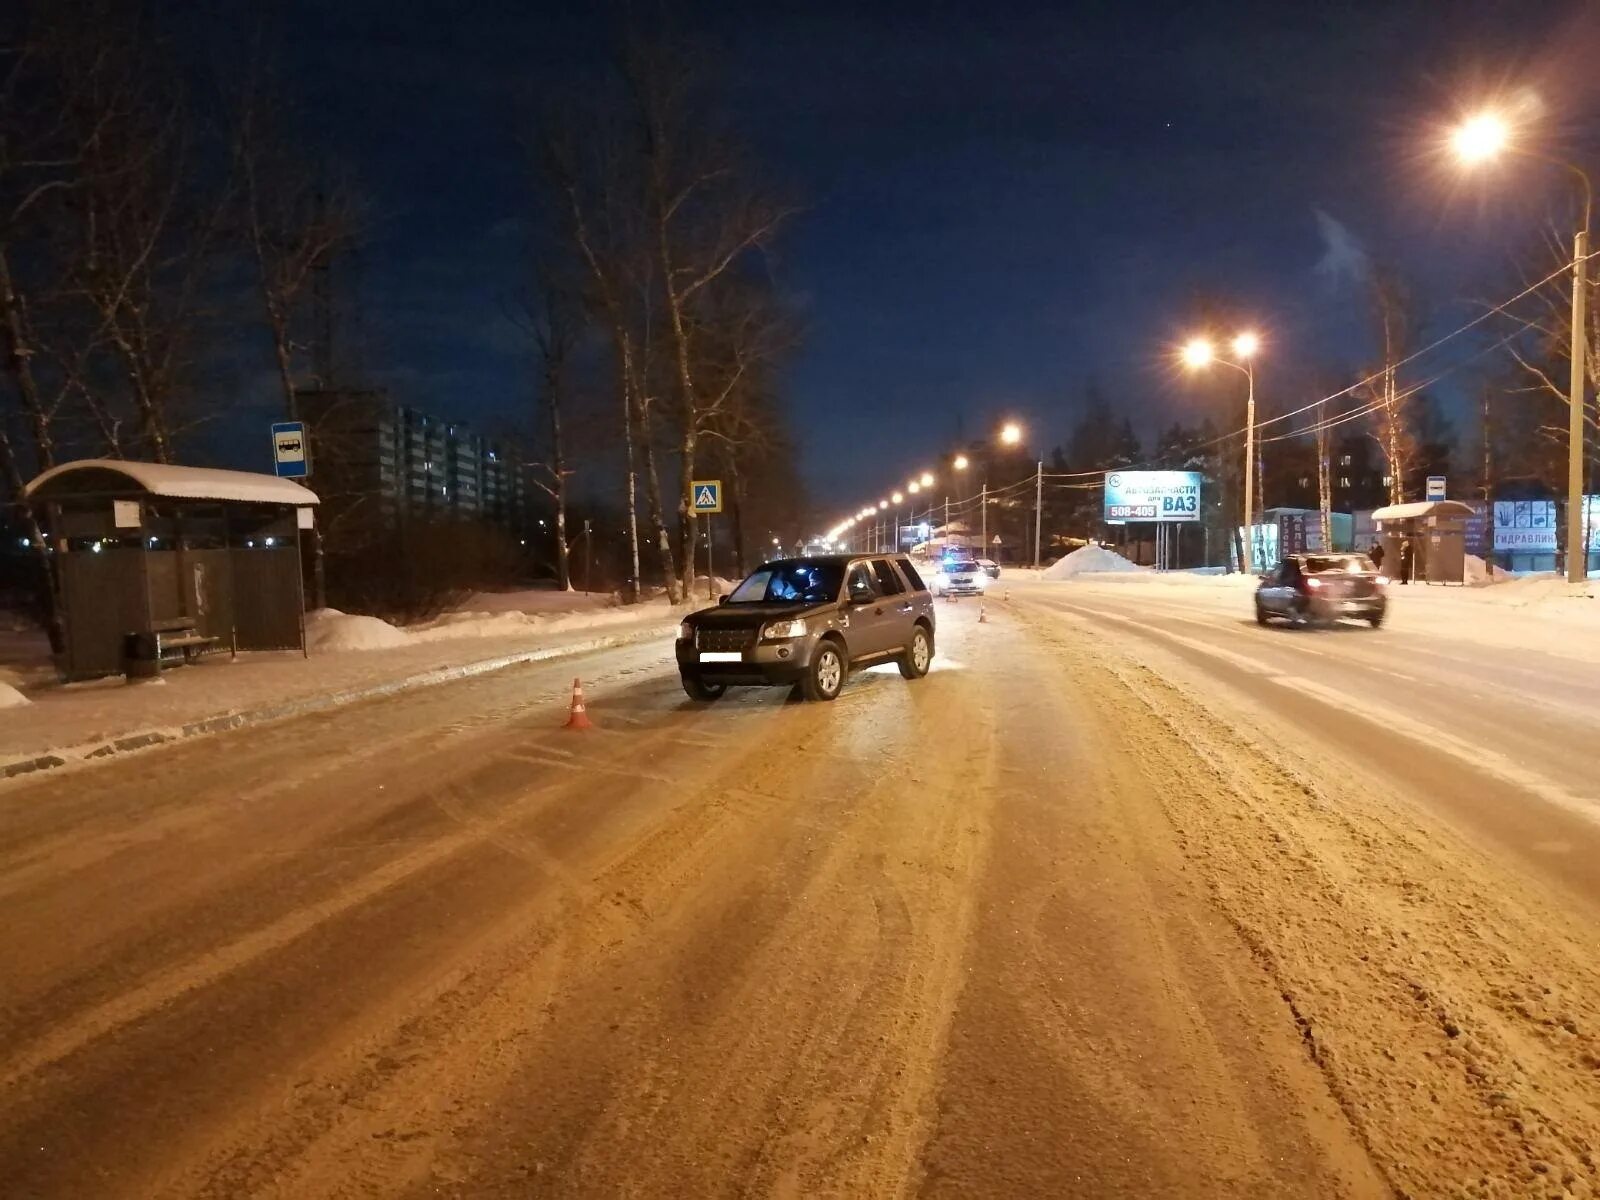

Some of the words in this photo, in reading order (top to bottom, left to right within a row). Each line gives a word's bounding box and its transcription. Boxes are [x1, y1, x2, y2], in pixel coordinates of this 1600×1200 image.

[1163, 496, 1197, 512] ВАЗ
[1111, 506, 1155, 517] 508-405
[1495, 534, 1556, 545] ГИДРАВЛИК
